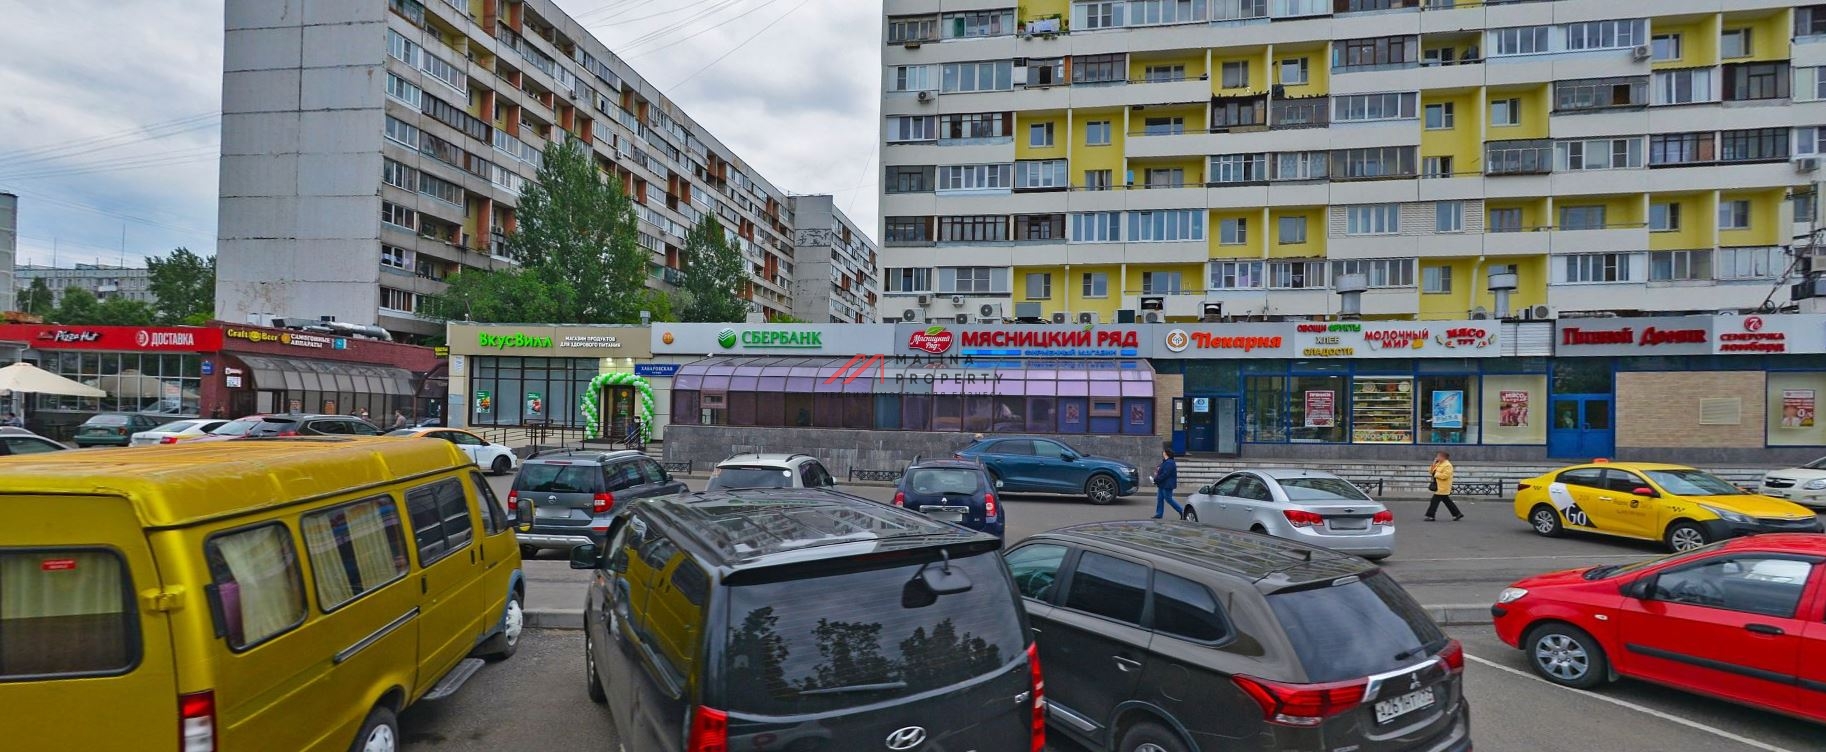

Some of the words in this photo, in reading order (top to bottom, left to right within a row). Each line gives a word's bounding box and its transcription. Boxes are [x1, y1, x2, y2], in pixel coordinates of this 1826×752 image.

[54, 331, 79, 342] Pizza
[80, 331, 98, 342] Hut
[151, 332, 194, 347] ДОСТАВКА
[227, 328, 248, 339] Craft
[261, 332, 278, 341] Beer
[741, 331, 822, 345] СБЕРБАНК
[961, 330, 1091, 348] МЯСНИЦКИЙ
[1097, 331, 1139, 348] РЯД
[1365, 328, 1429, 341] МОЛОЧНЫЙ
[1446, 328, 1486, 338] МЯСО
[1191, 332, 1283, 352] Пекарня
[1382, 339, 1409, 349] МИР
[1566, 504, 1587, 526] Go
